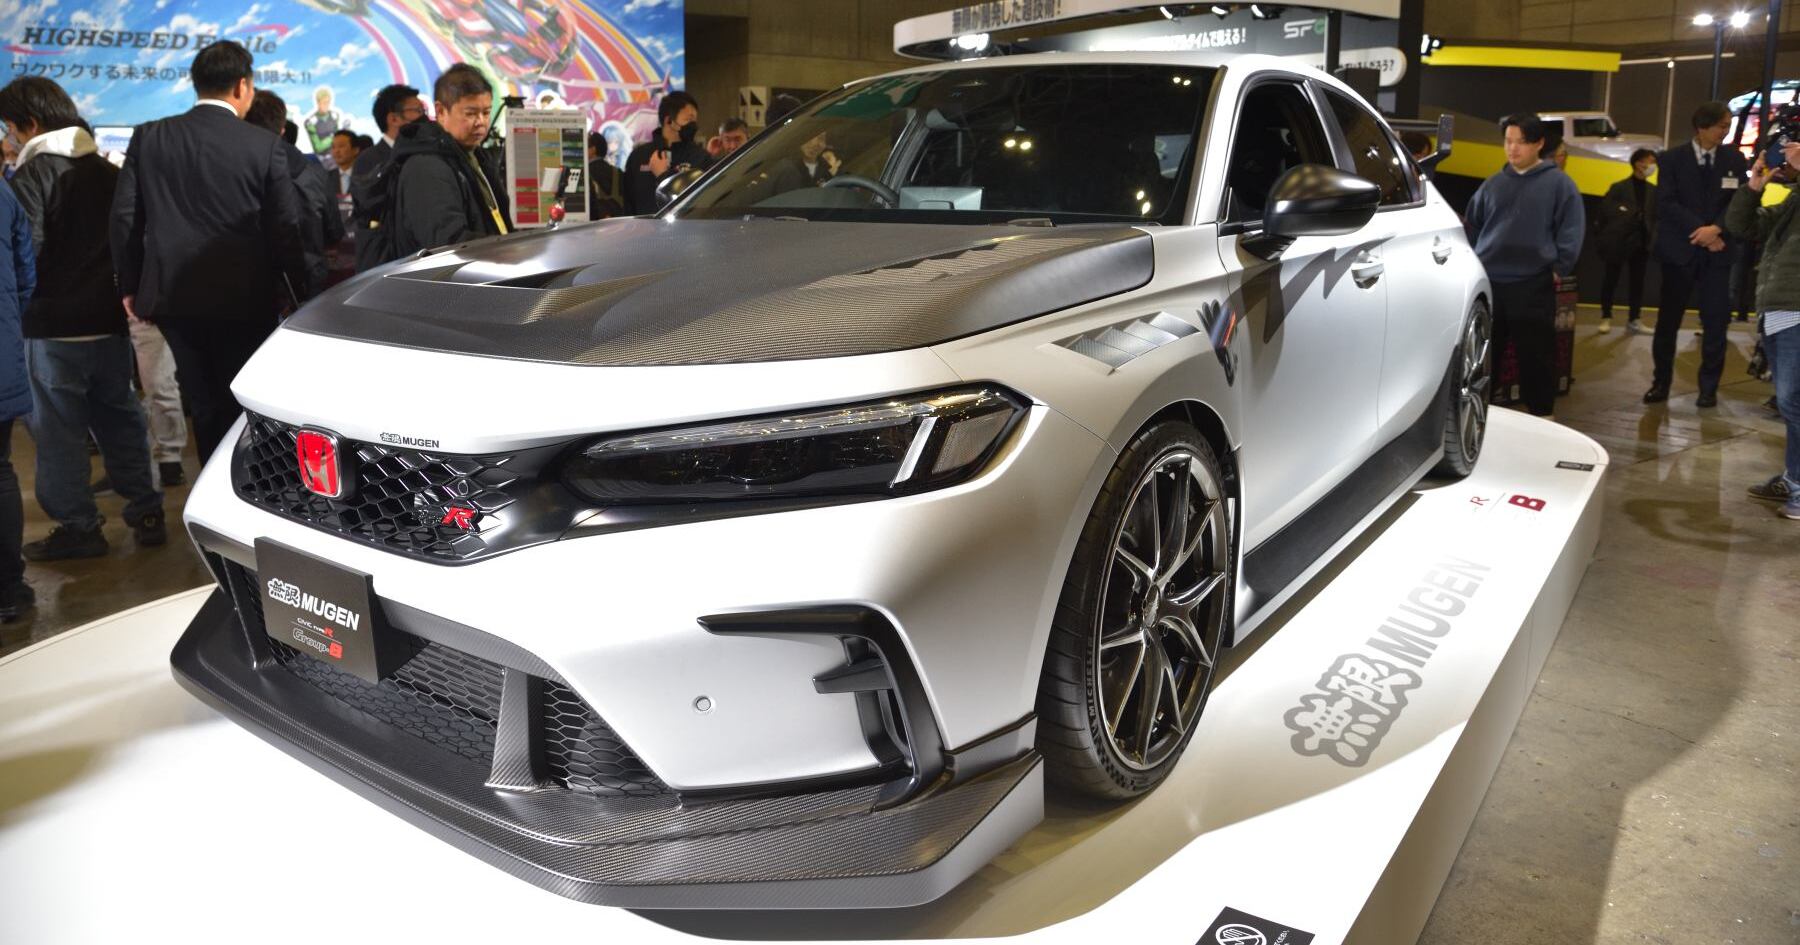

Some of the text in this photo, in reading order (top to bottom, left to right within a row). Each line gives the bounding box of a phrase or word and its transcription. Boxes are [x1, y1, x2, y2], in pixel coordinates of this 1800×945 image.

[21, 26, 189, 50] HIGHSPEED
[402, 436, 440, 449] MUGEN
[1507, 494, 1547, 512] B
[301, 592, 360, 631] MUGEN
[1365, 553, 1492, 668] MUGEN
[1085, 636, 1097, 717] MICHELIN
